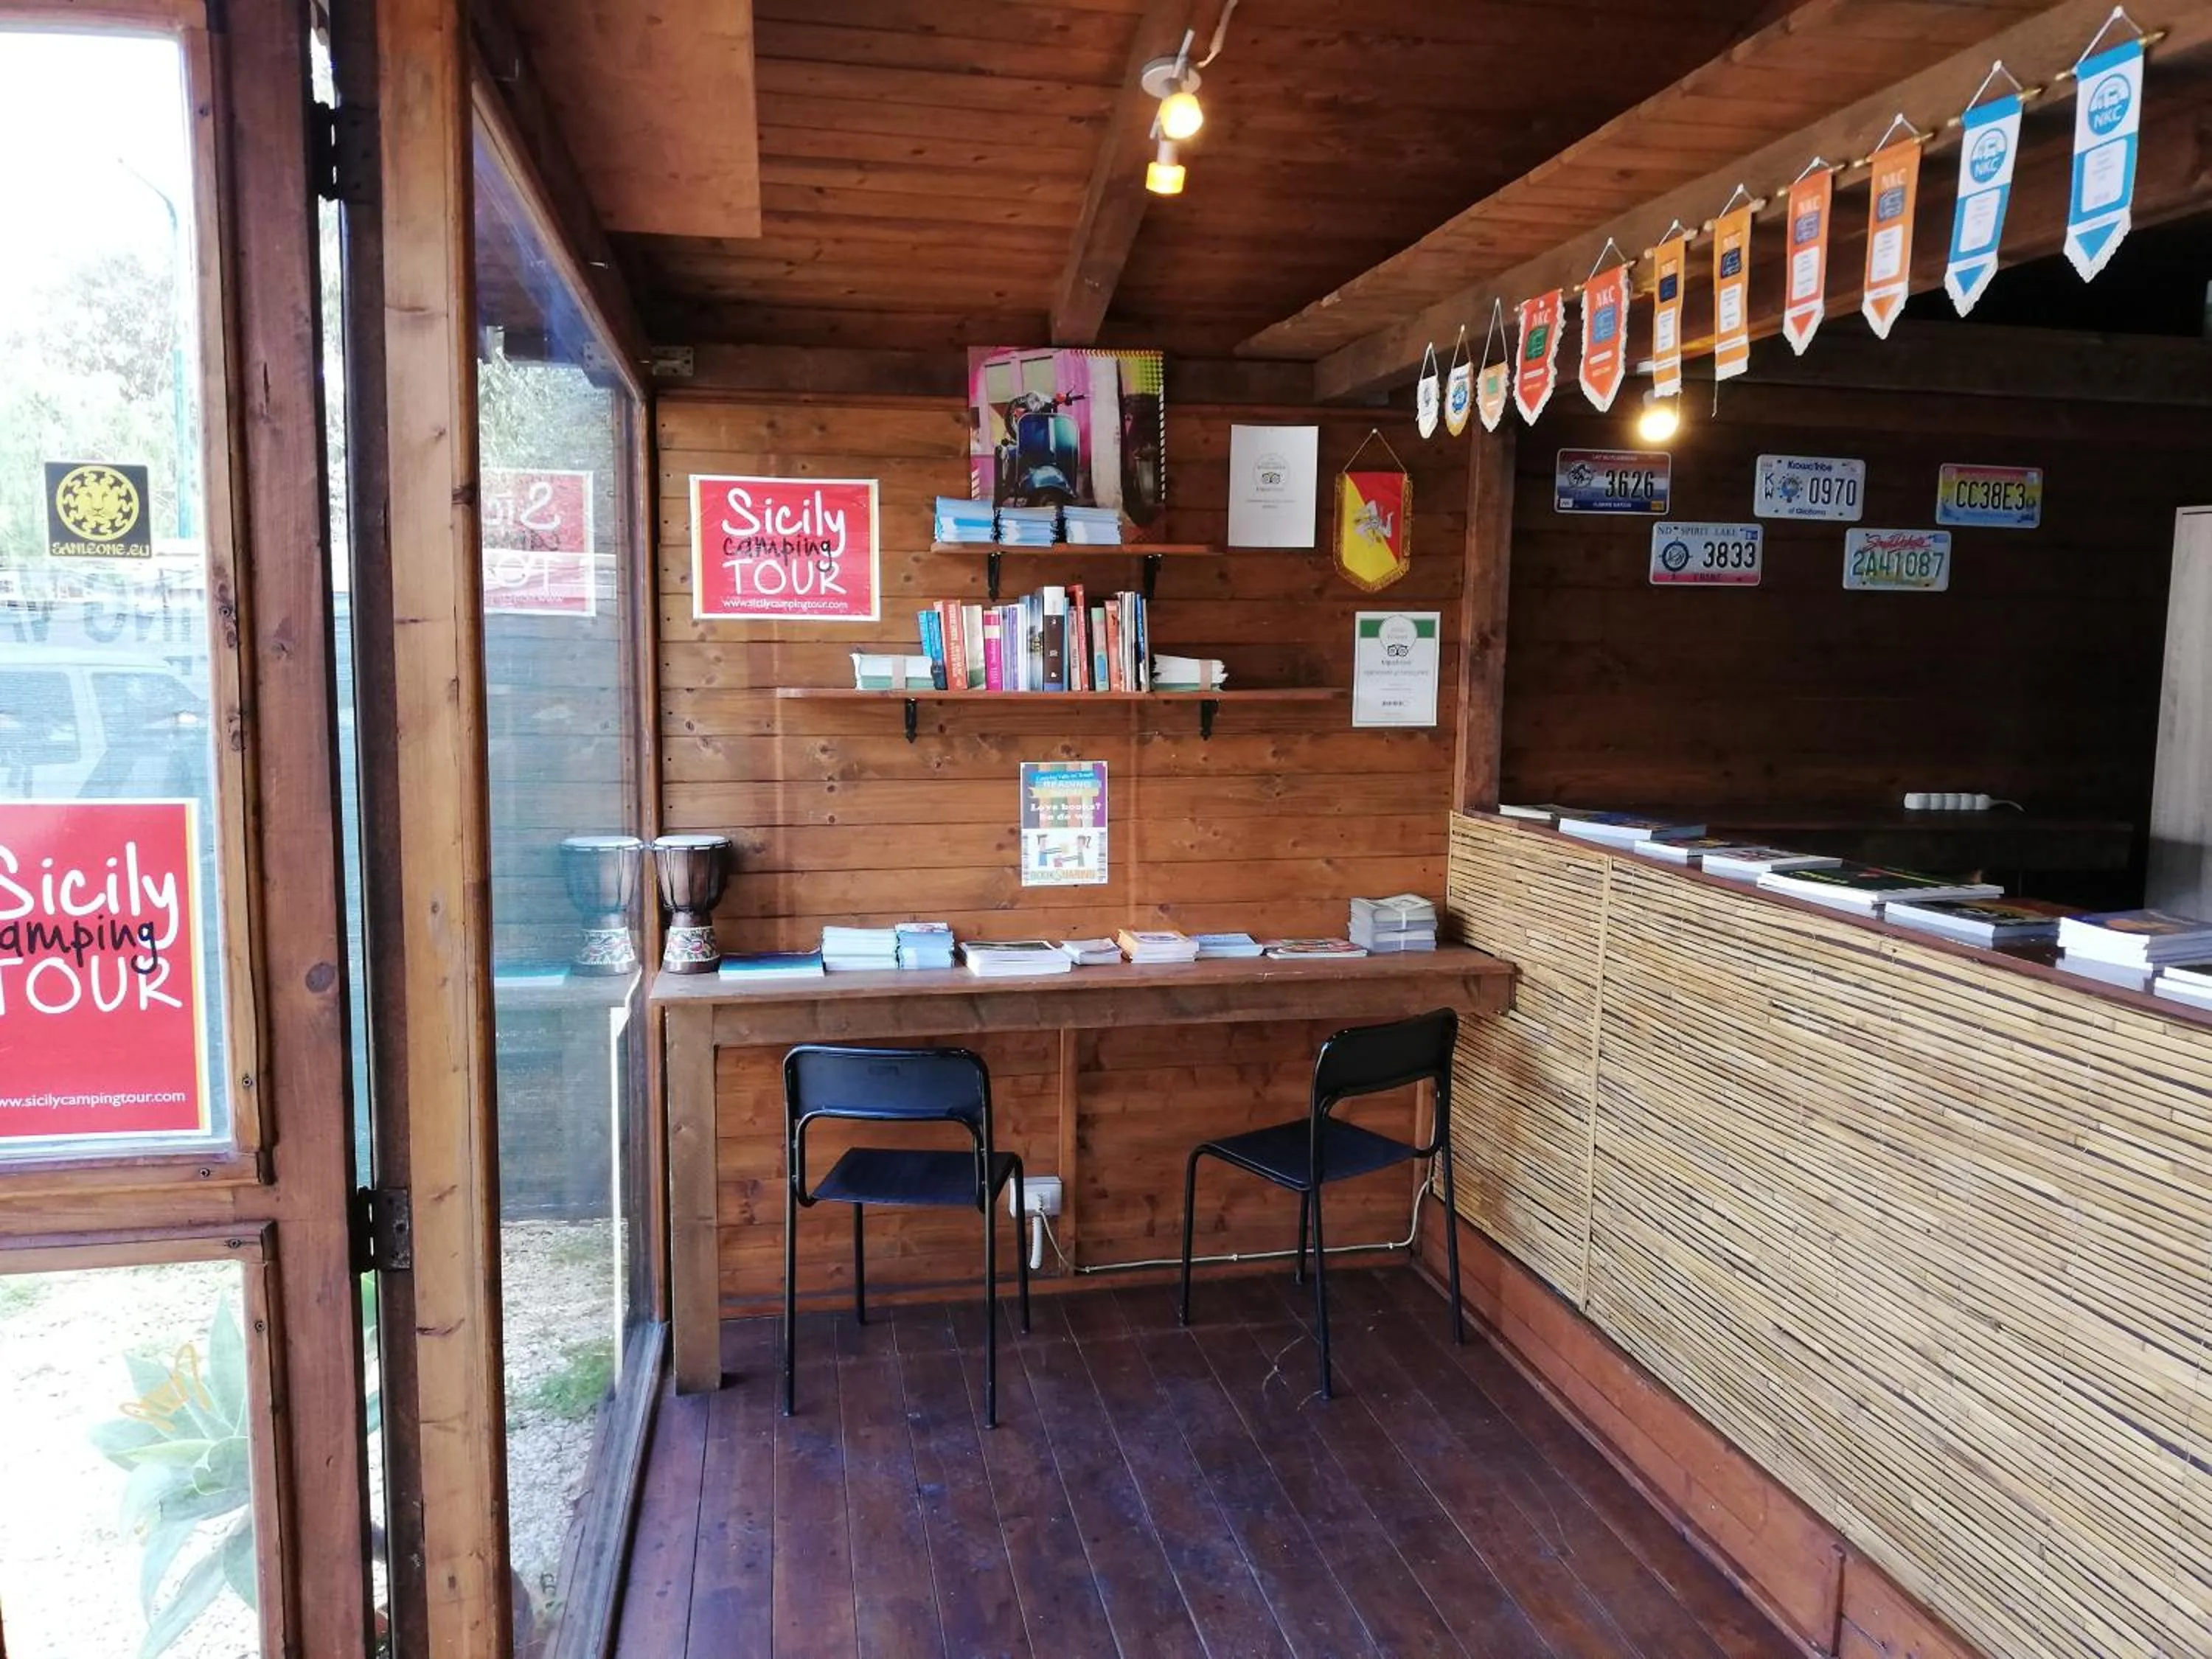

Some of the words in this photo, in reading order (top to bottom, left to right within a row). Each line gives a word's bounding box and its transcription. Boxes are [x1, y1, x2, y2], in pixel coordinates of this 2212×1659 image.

[1604, 470, 1654, 498] 3626
[1809, 477, 1857, 507] 0970
[1956, 481, 2026, 510] CC38E3
[721, 487, 846, 558] Sicily
[723, 534, 832, 572] camping
[1703, 540, 1756, 568] 3833
[722, 558, 847, 595] TOUR
[722, 598, 848, 611] www.sicilycampingtour.com
[0, 841, 179, 949] Sicily
[0, 915, 158, 974] amping
[0, 1092, 186, 1109] ww.sicilycampingtour.com
